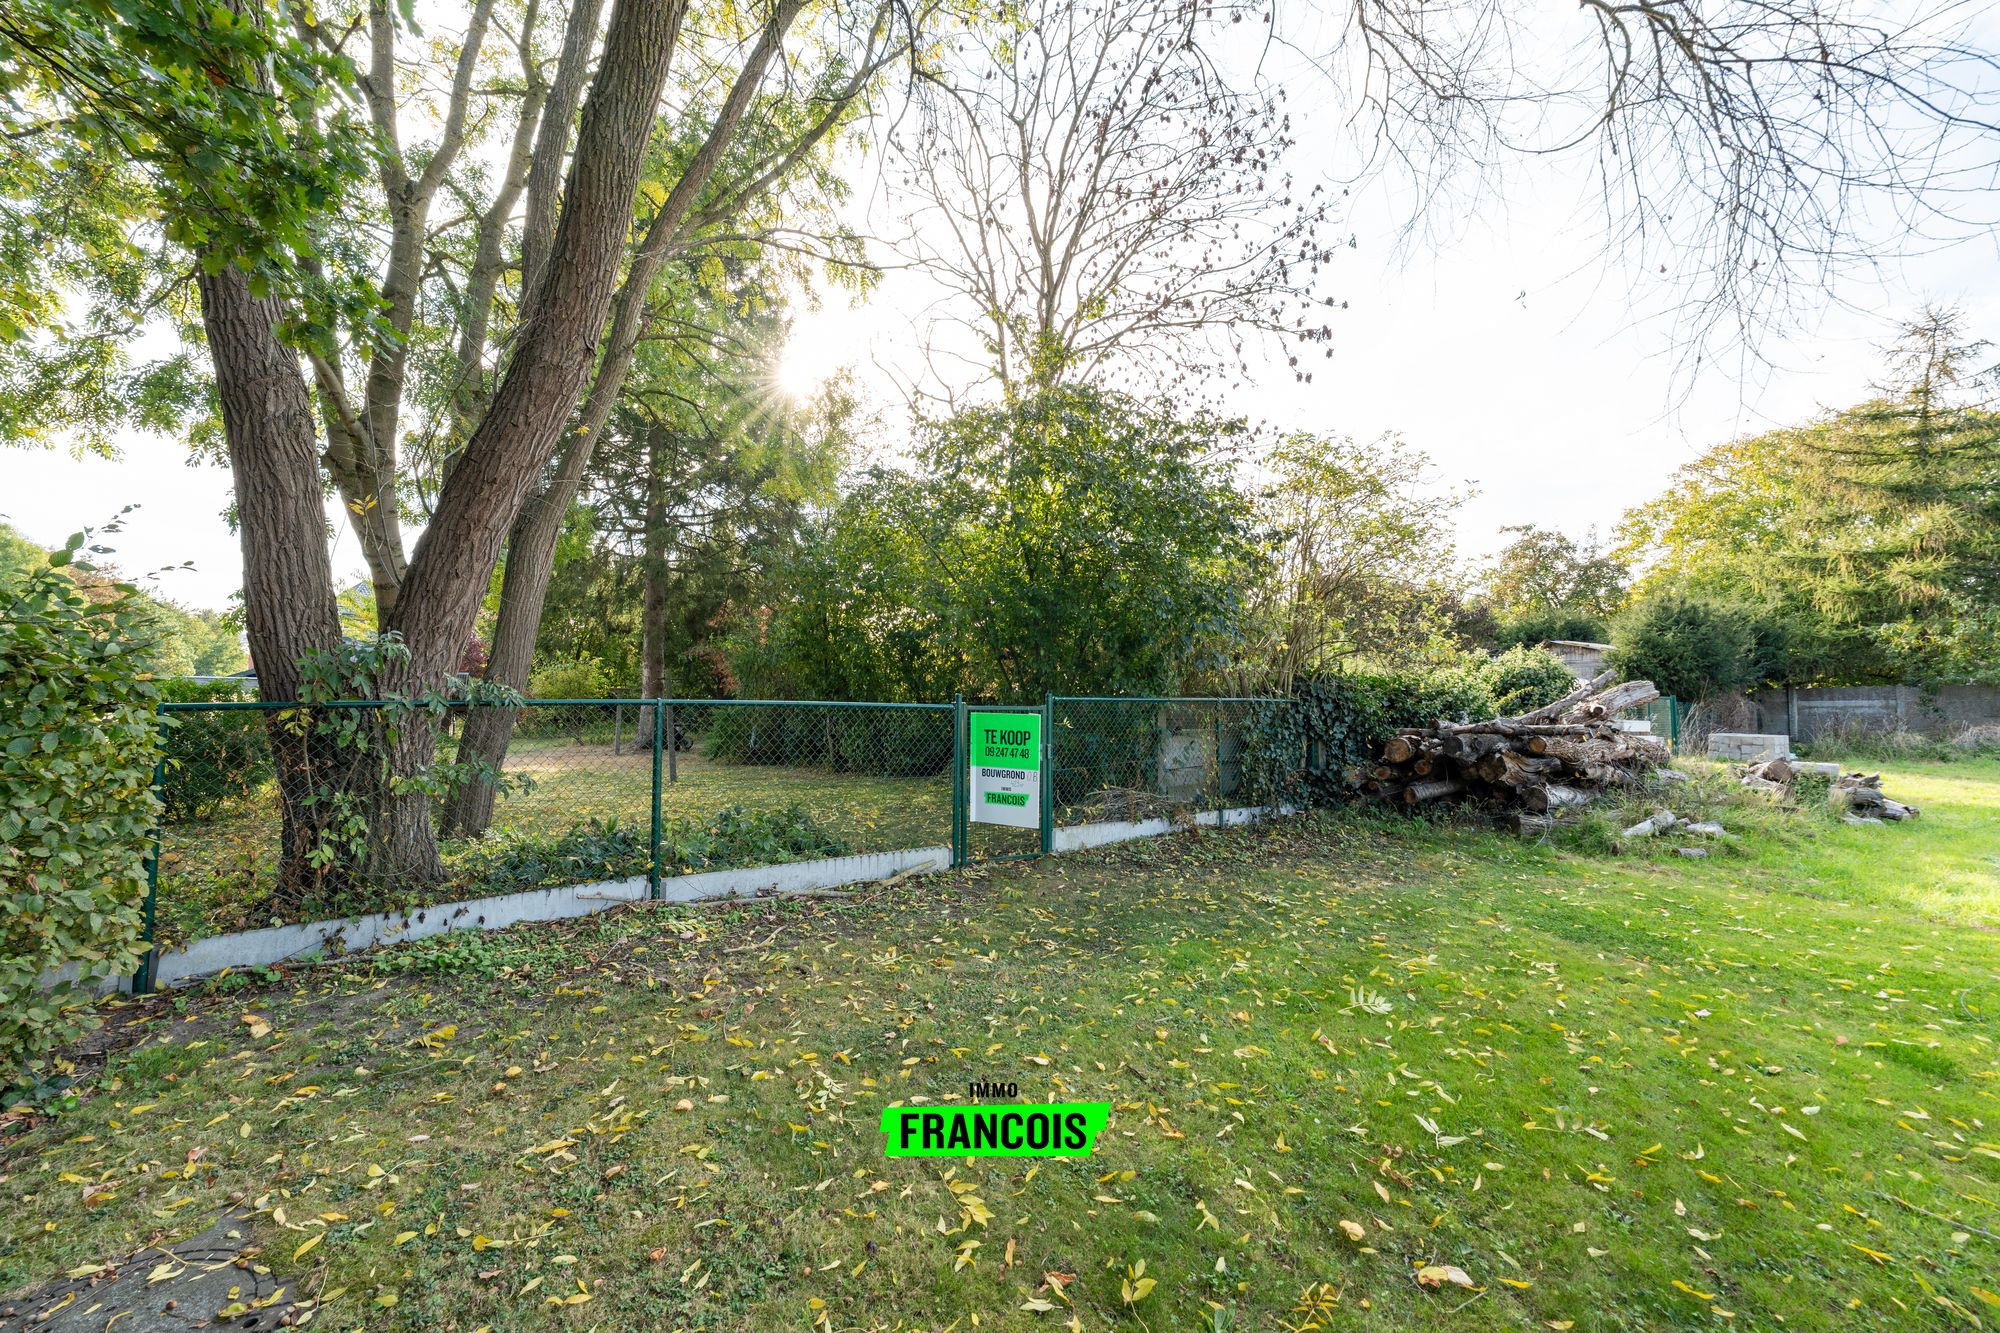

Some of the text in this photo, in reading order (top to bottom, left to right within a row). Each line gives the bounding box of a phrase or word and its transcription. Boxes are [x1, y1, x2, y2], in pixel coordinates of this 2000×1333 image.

[984, 729, 1031, 746] TE KOOP
[985, 747, 1029, 759] 09 247 47 48
[981, 768, 1025, 780] BOUWGROND
[987, 793, 1025, 806] FRANCOIS
